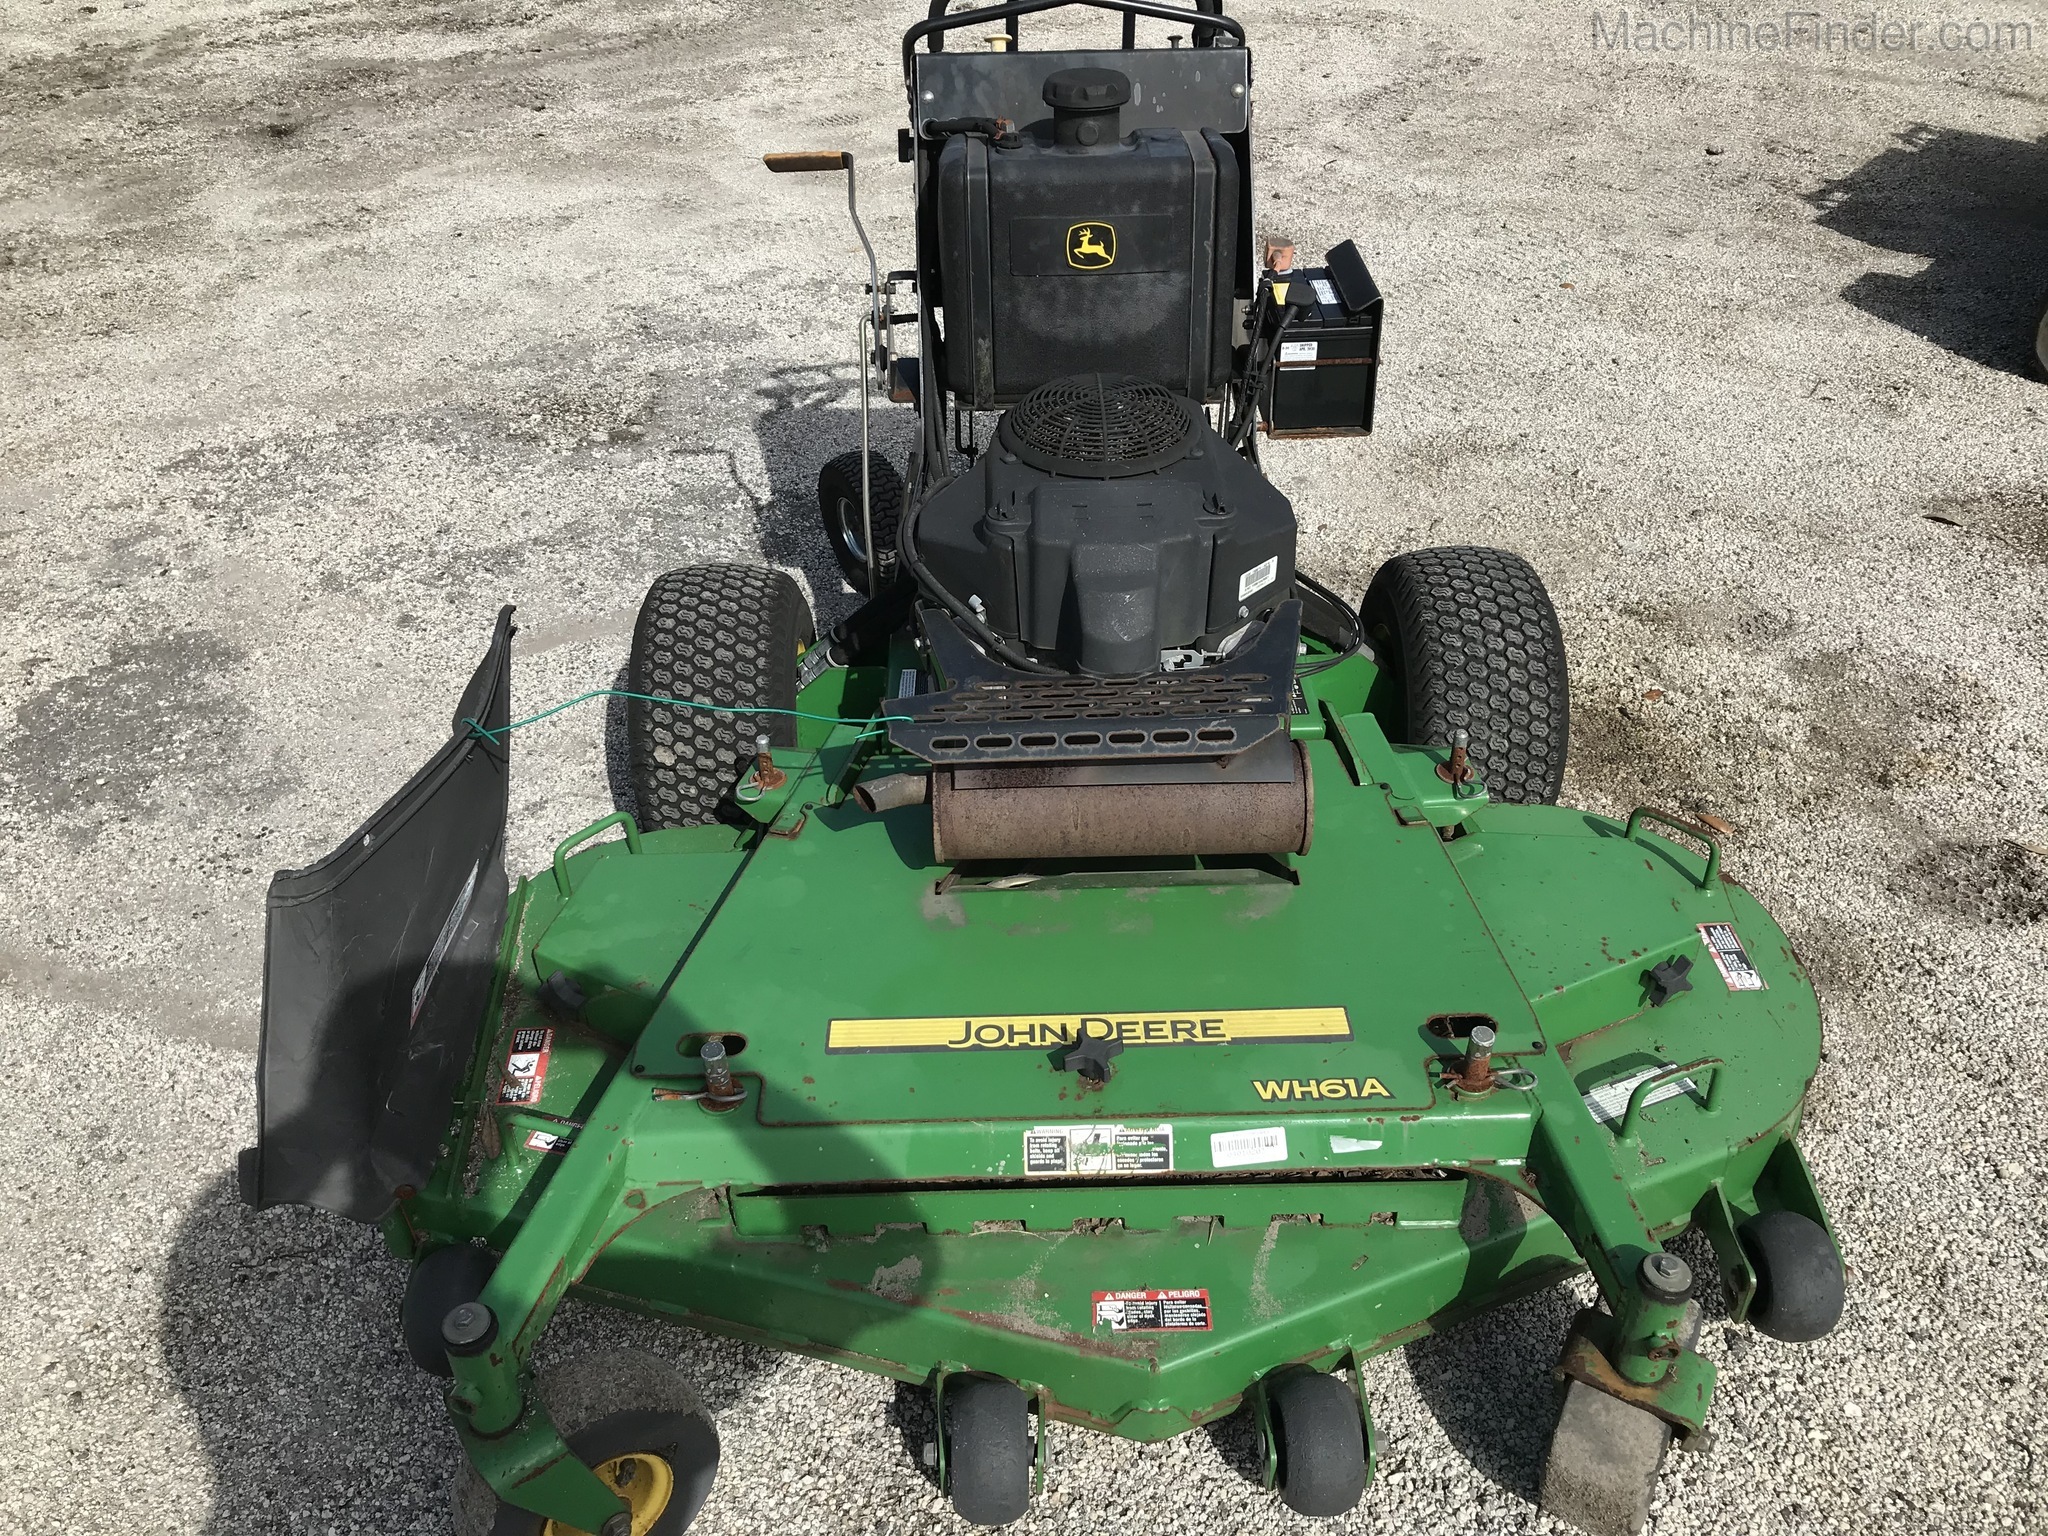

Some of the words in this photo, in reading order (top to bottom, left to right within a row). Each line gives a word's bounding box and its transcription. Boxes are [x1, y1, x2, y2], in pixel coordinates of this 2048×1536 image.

[948, 1020, 1067, 1045] JOHN
[1080, 1018, 1226, 1041] DEERE
[1252, 1077, 1393, 1100] WH61A
[1168, 1290, 1200, 1298] PELIGRO
